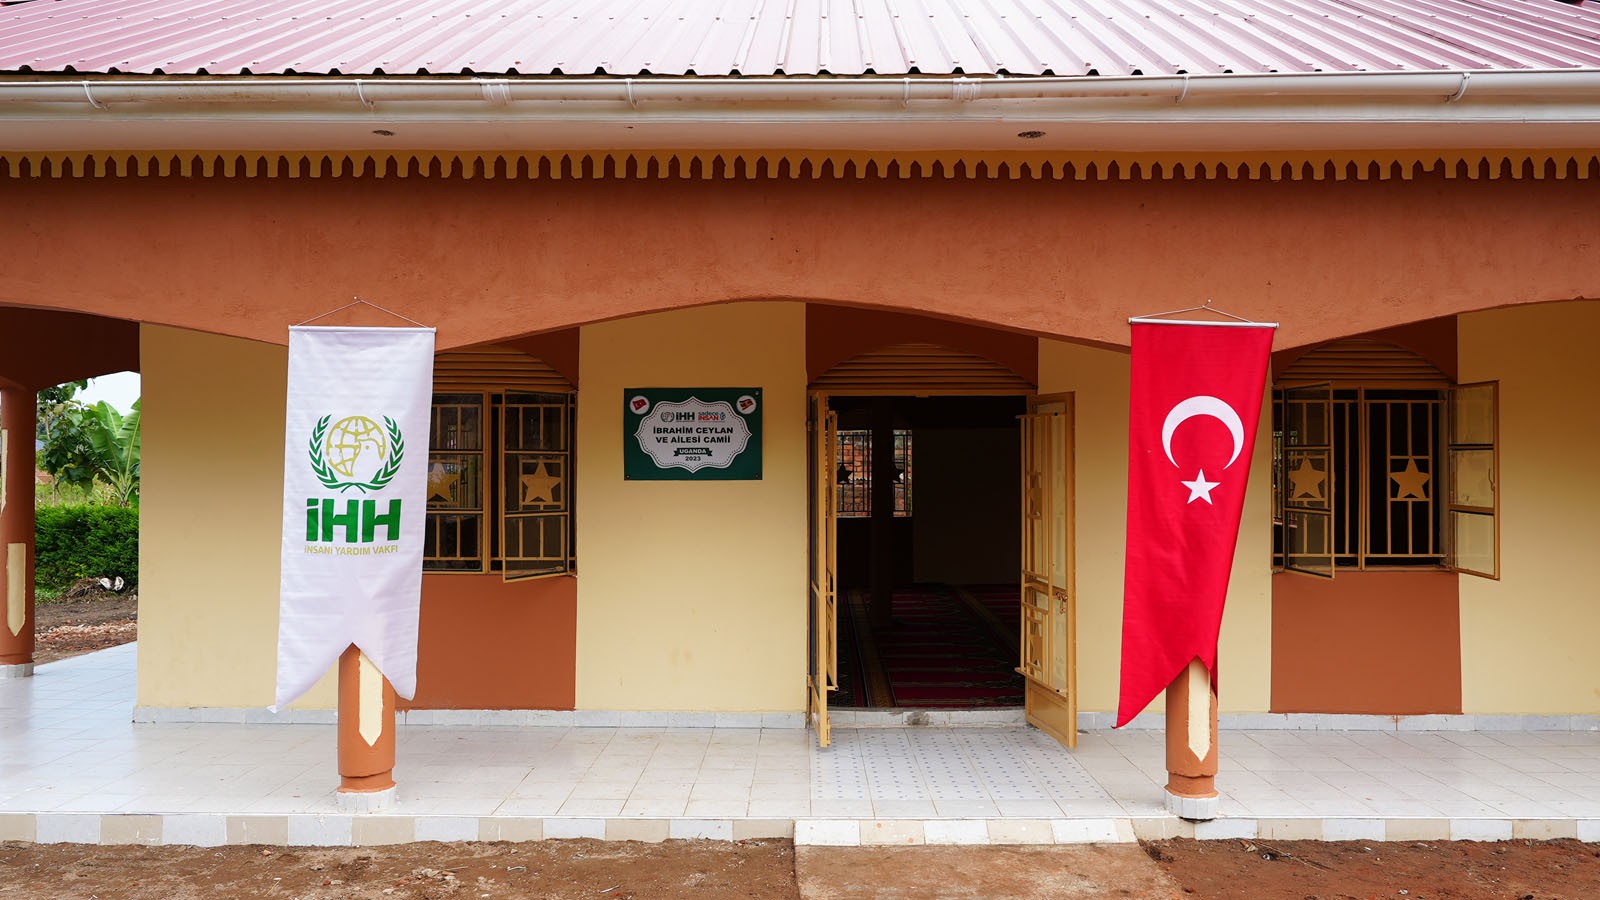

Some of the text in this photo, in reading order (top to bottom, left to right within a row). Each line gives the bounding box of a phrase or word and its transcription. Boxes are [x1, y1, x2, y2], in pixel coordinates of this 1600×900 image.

[653, 426, 693, 434] İBRAHİM
[671, 435, 701, 443] AİLESİ
[703, 435, 731, 443] CAMİİ
[335, 546, 371, 556] YARDIM
[373, 544, 399, 555] VAKFI
